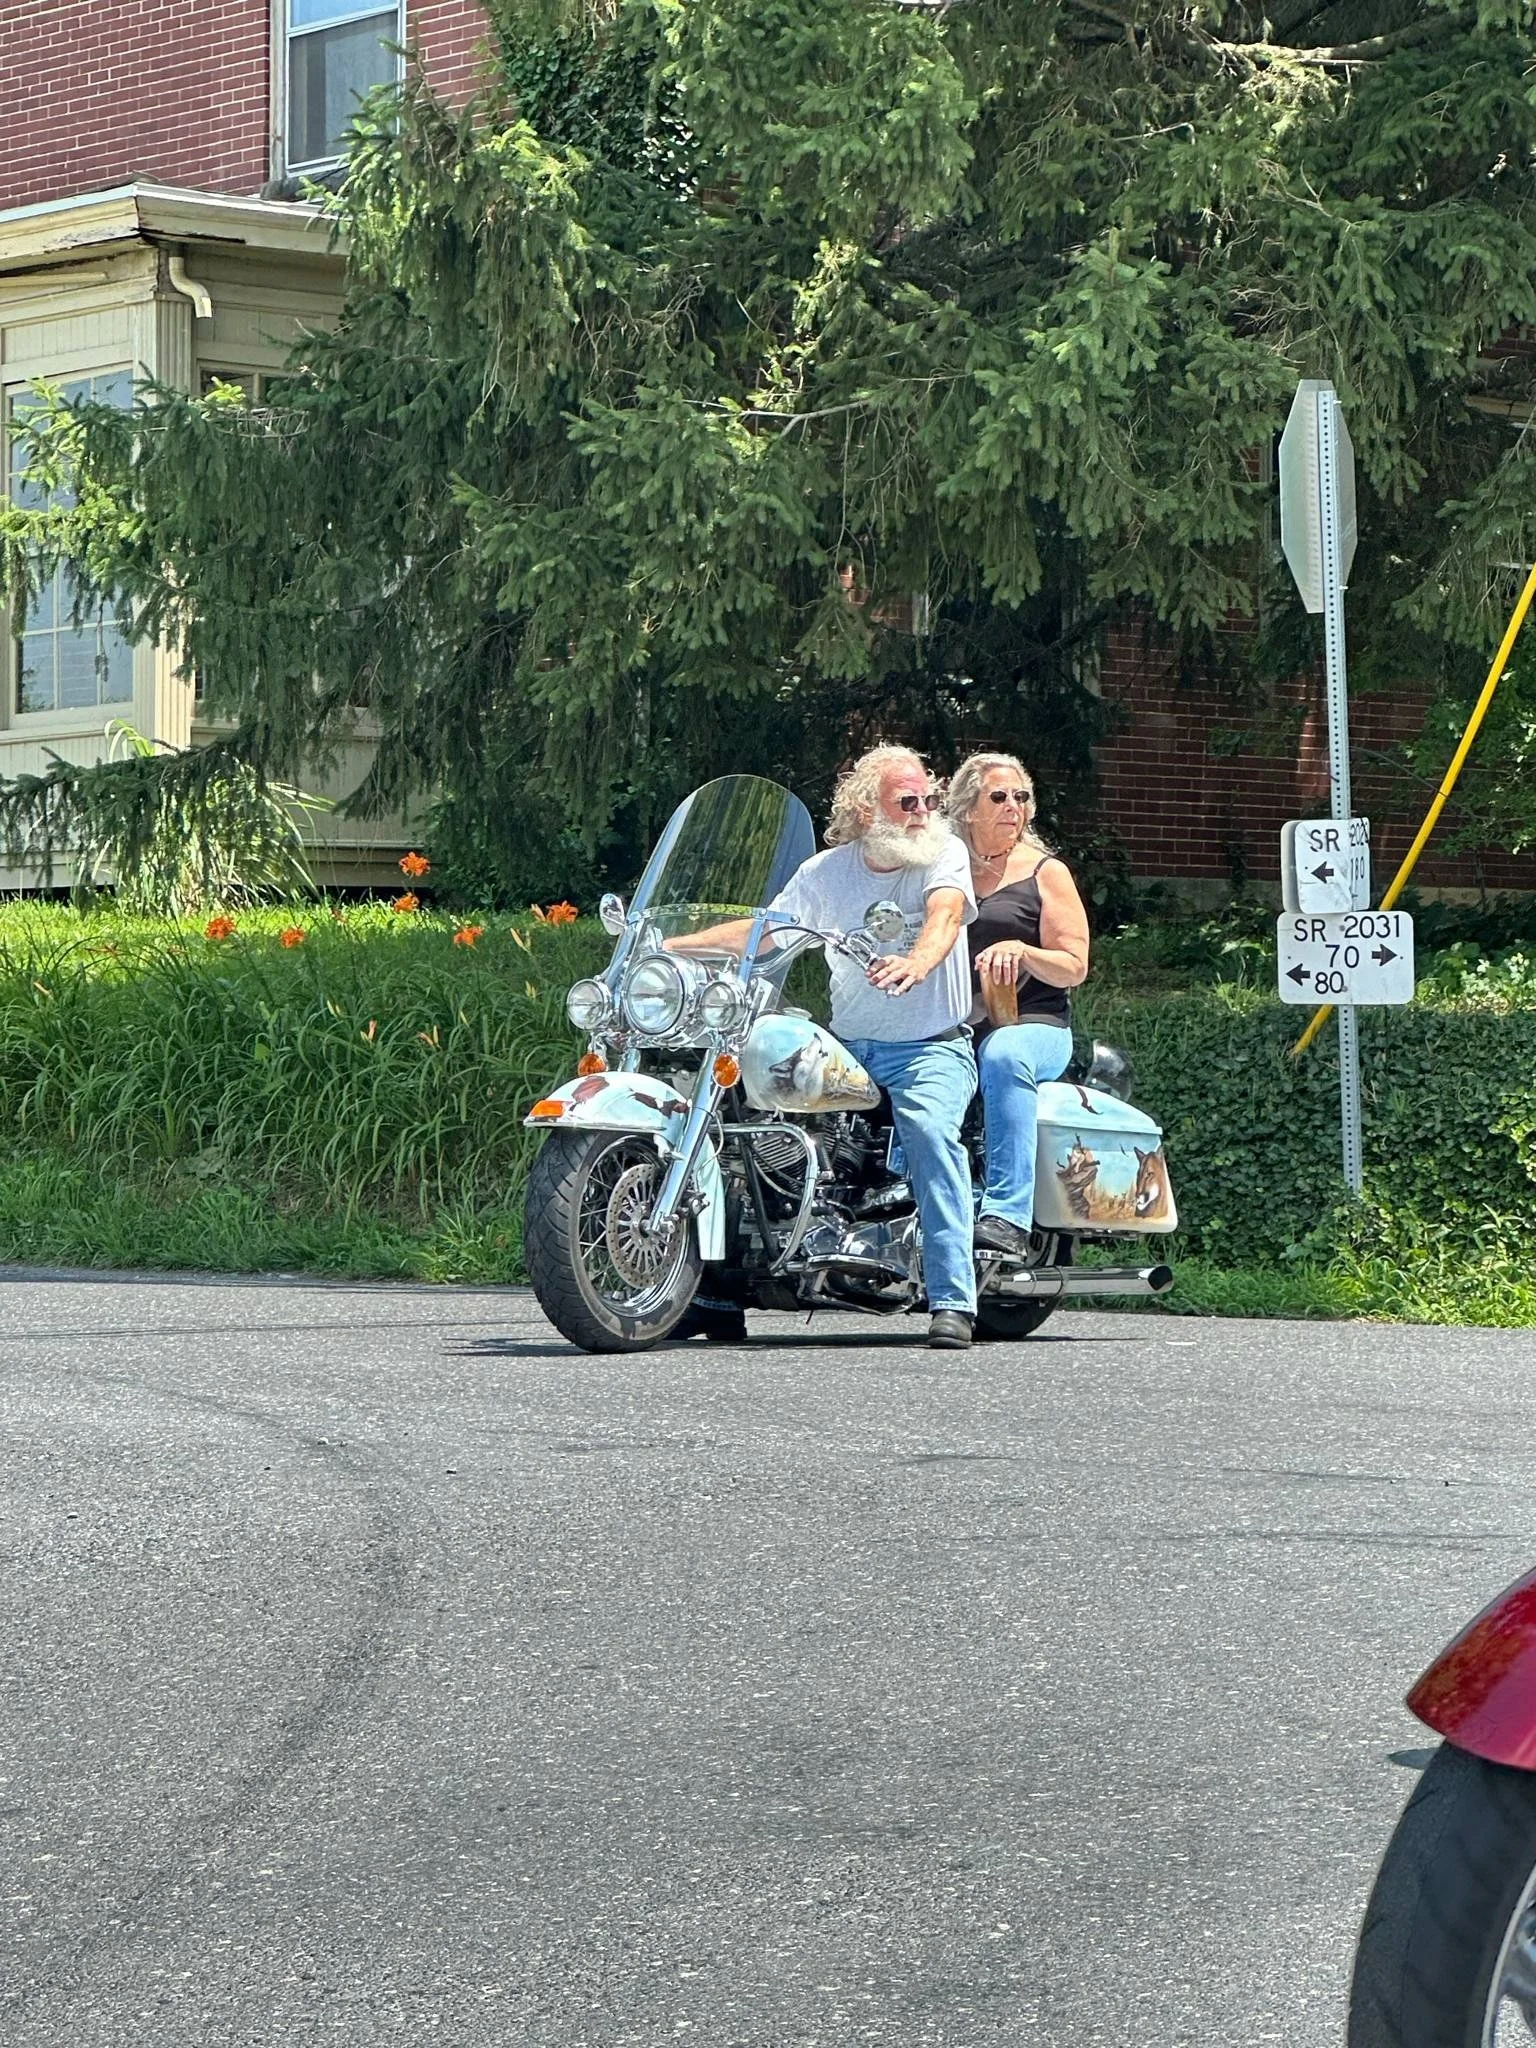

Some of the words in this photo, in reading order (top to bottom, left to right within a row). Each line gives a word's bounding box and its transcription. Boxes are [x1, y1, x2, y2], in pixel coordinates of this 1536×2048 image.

[1310, 828, 1340, 852] SR
[1294, 918, 1326, 942] SR
[1343, 914, 1400, 939] 2031
[1325, 944, 1360, 969] 70
[1314, 971, 1345, 995] 80
